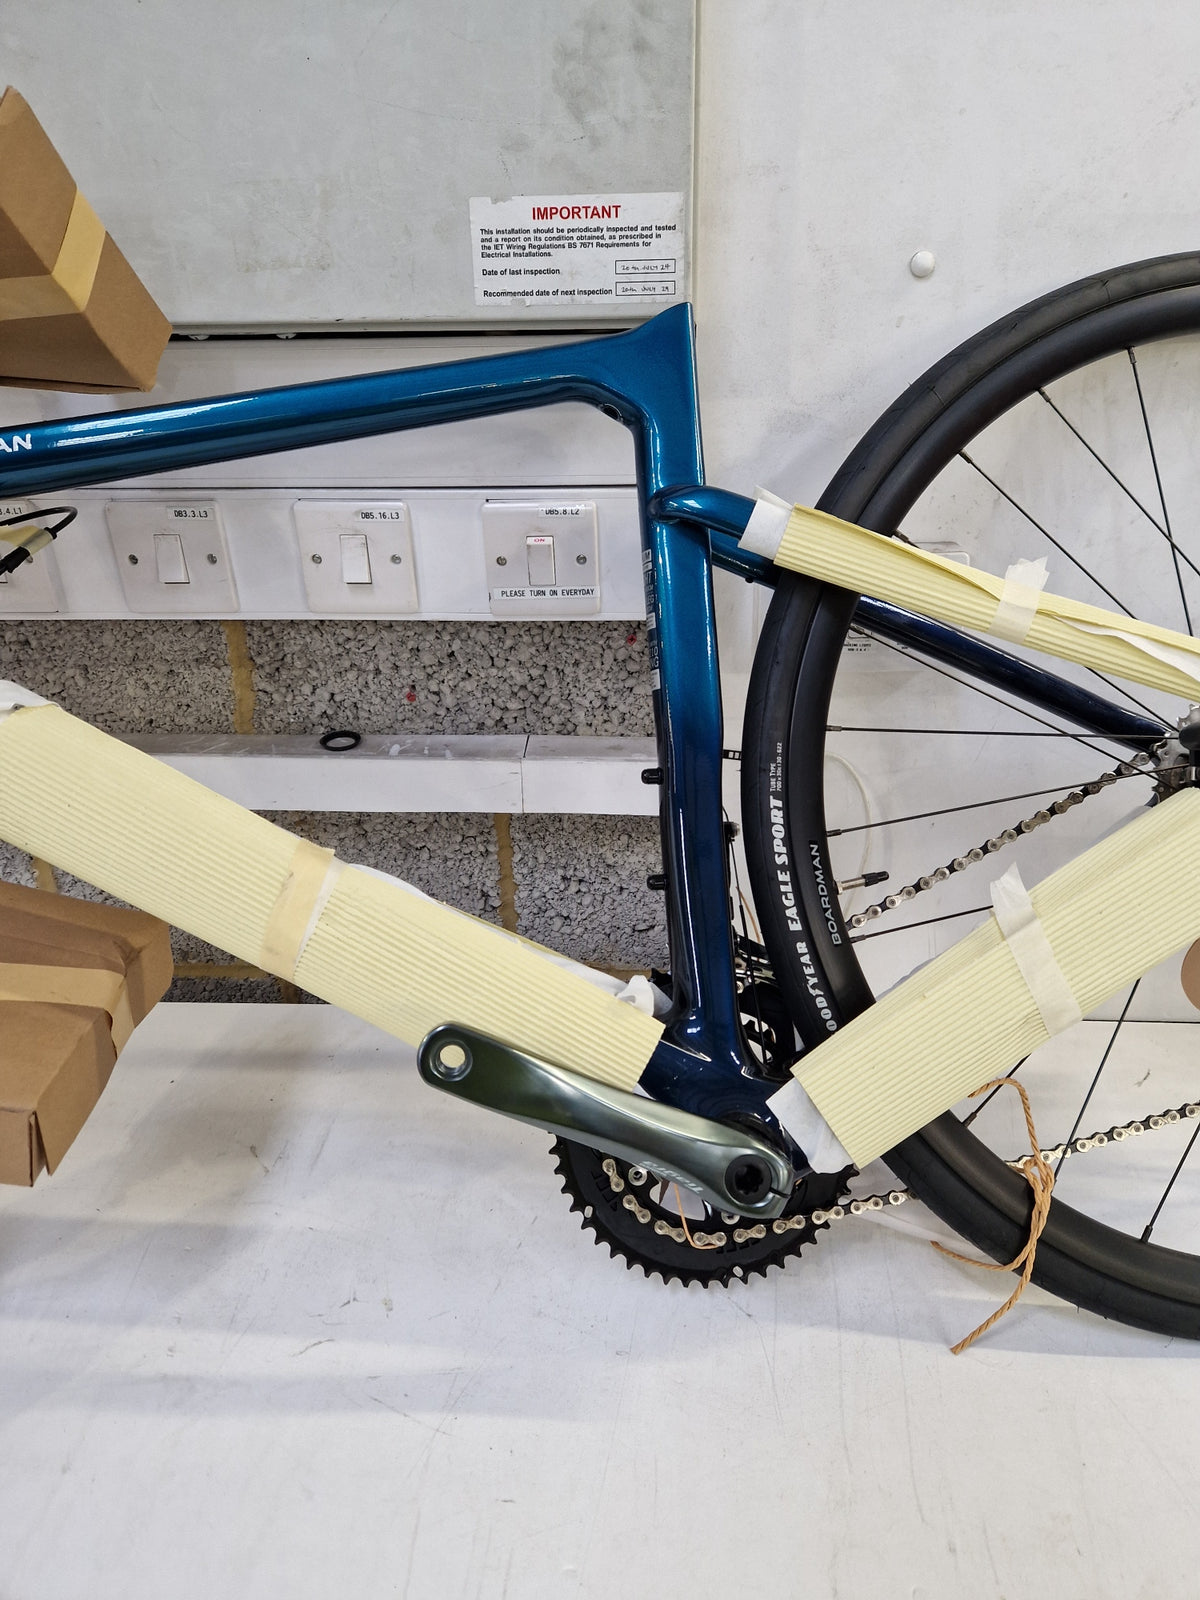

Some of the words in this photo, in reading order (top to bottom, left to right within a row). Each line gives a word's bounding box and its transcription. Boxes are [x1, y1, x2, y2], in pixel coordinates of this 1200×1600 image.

[532, 205, 621, 220] IMPORTANT
[567, 226, 604, 234] periodically
[606, 225, 638, 233] inspected
[501, 236, 521, 244] report
[576, 233, 606, 241] obtained,
[618, 232, 653, 240] prescribed
[506, 243, 526, 251] Wiring
[596, 241, 639, 249] Requirements
[482, 268, 498, 276] Date
[499, 268, 507, 276] of
[523, 267, 560, 276] inspection
[577, 288, 612, 296] inspection
[173, 509, 208, 518] DB3.3.L3
[360, 511, 400, 520] DB5.16.L3
[501, 589, 525, 597] PLEASE
[530, 589, 546, 597] TURN
[549, 589, 558, 597] ON
[561, 588, 595, 596] EVERYDAY
[769, 763, 777, 777] TYPE
[769, 778, 777, 792] TUBE
[769, 795, 789, 866] SPORT
[777, 870, 803, 931] EAGLE
[809, 844, 843, 945] BOARDMAN
[796, 941, 838, 1032] OODYEAR
